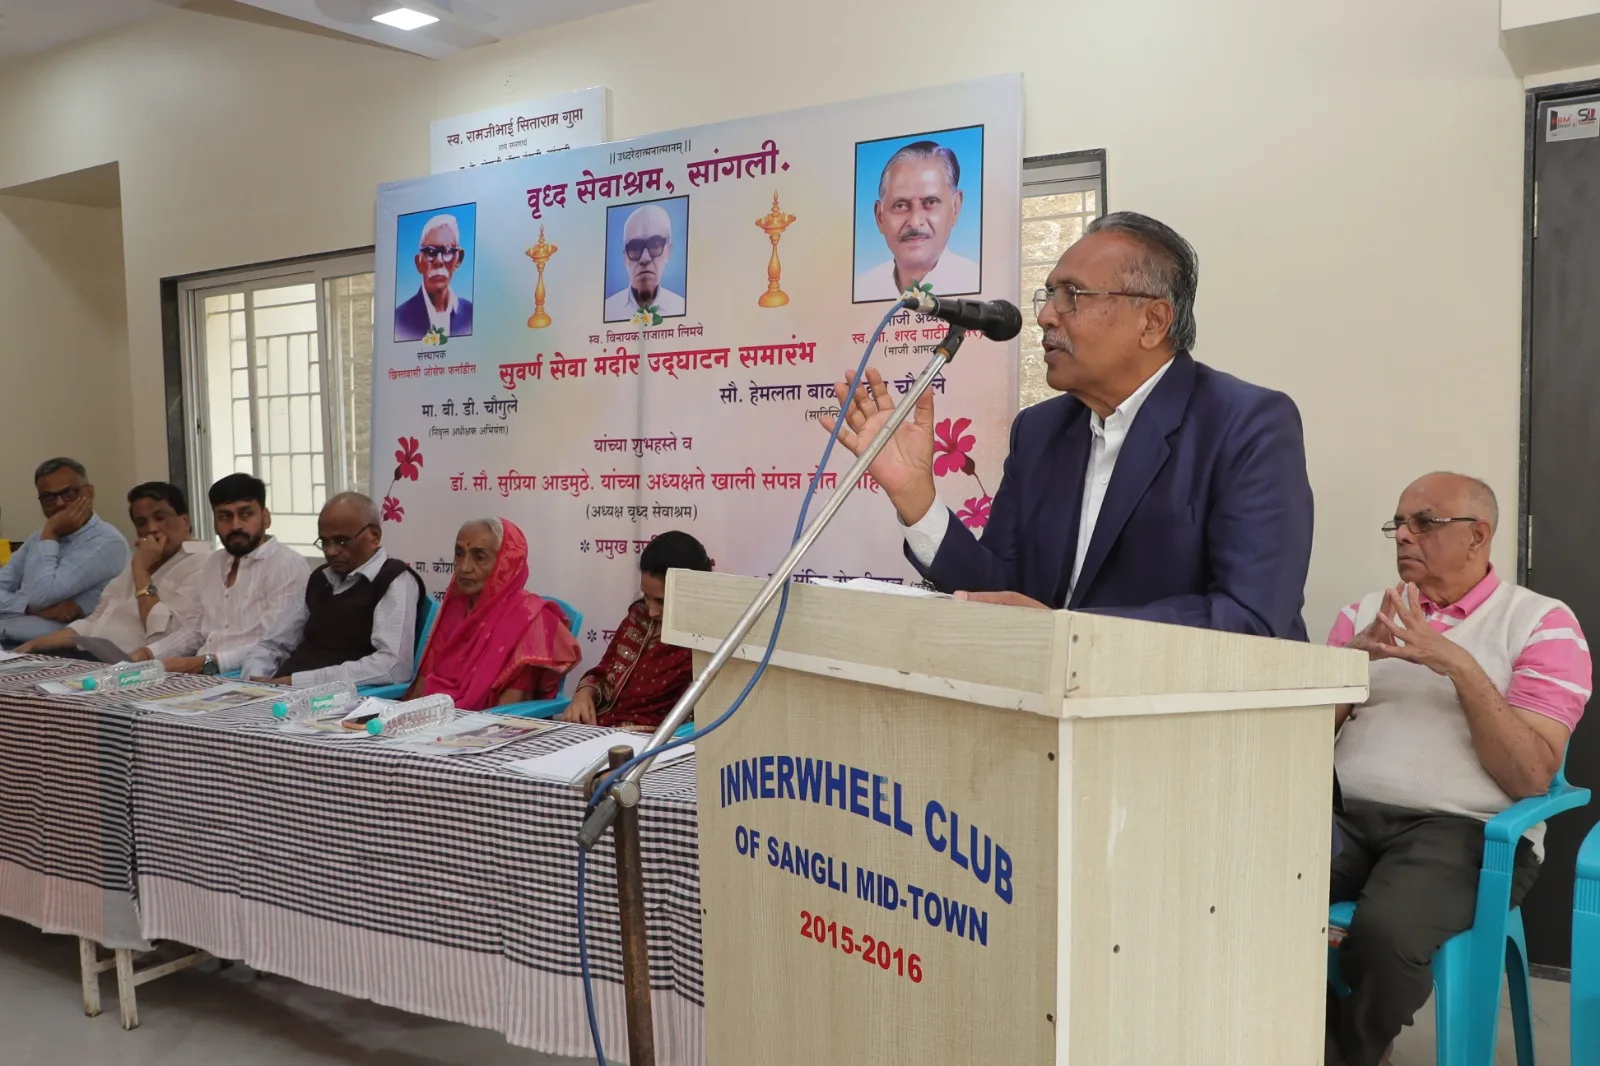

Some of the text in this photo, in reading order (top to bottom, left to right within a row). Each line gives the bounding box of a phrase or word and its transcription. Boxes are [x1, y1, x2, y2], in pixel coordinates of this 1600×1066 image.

[446, 108, 583, 147] स्व. रामजीभाई सिताराम गुप्ता
[576, 167, 675, 204] सेवाश्रम,
[687, 139, 790, 187] सांगली.
[589, 322, 703, 345] स्व. विनायक राजाराम लिमये
[852, 332, 868, 345] स्व.
[895, 329, 918, 342] शरद
[499, 353, 543, 390] सुवर्ण
[549, 352, 587, 380] सेवा
[594, 346, 640, 378] मंदीर
[738, 334, 816, 370] समारंभ
[421, 404, 438, 418] मा.
[462, 396, 479, 416] डी.
[483, 393, 518, 420] चौगुले
[719, 381, 743, 405] सौ.
[749, 380, 802, 407] हेमलता
[594, 432, 693, 457] यांच्या शुभहस्ते व
[450, 471, 467, 491] डॉ.
[472, 470, 492, 492] सौ.
[497, 469, 536, 497] सुप्रिया
[600, 467, 641, 491] यांच्या
[646, 466, 706, 492] अध्यक्षते
[711, 466, 756, 490] खाली
[762, 466, 802, 491] संपन्न
[586, 503, 624, 520] (अध्यक्ष
[652, 501, 698, 519] सेवाश्रम)
[595, 539, 628, 560] प्रमुख
[415, 561, 429, 573] मा.
[720, 755, 1013, 905] INNERWHEEL CLUB
[735, 825, 988, 947] OF SANGLI MID-TOWN
[800, 910, 922, 983] 2015-2016
